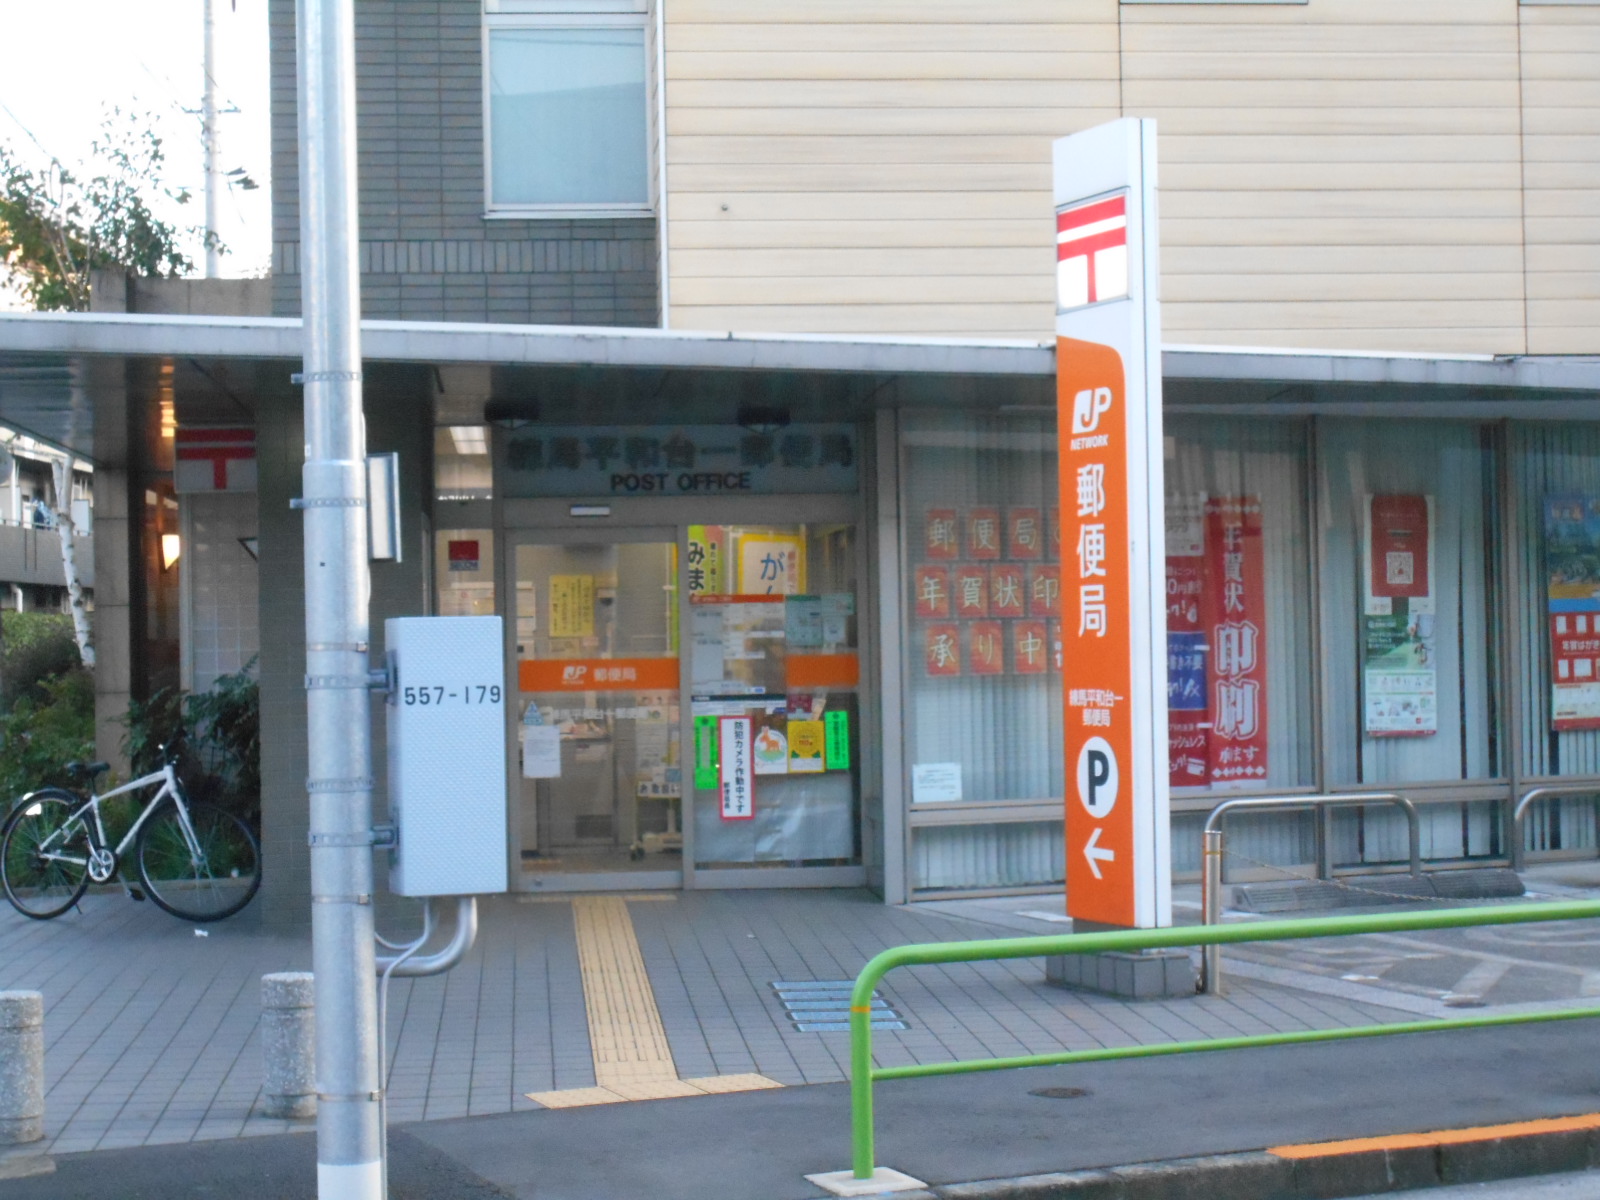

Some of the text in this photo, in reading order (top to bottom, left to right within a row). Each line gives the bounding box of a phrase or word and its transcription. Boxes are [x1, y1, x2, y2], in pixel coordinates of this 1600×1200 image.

[1070, 434, 1109, 450] NETWORK
[610, 472, 751, 491] POST OFFICE
[928, 518, 1059, 551] 郵便局
[1076, 463, 1107, 637] 郵便局
[918, 575, 1059, 611] 年賀状印
[930, 631, 1043, 668] 承り中
[404, 685, 501, 705] 557-179
[734, 721, 745, 813] 防犯カメラ作動中です
[1087, 750, 1109, 805] P
